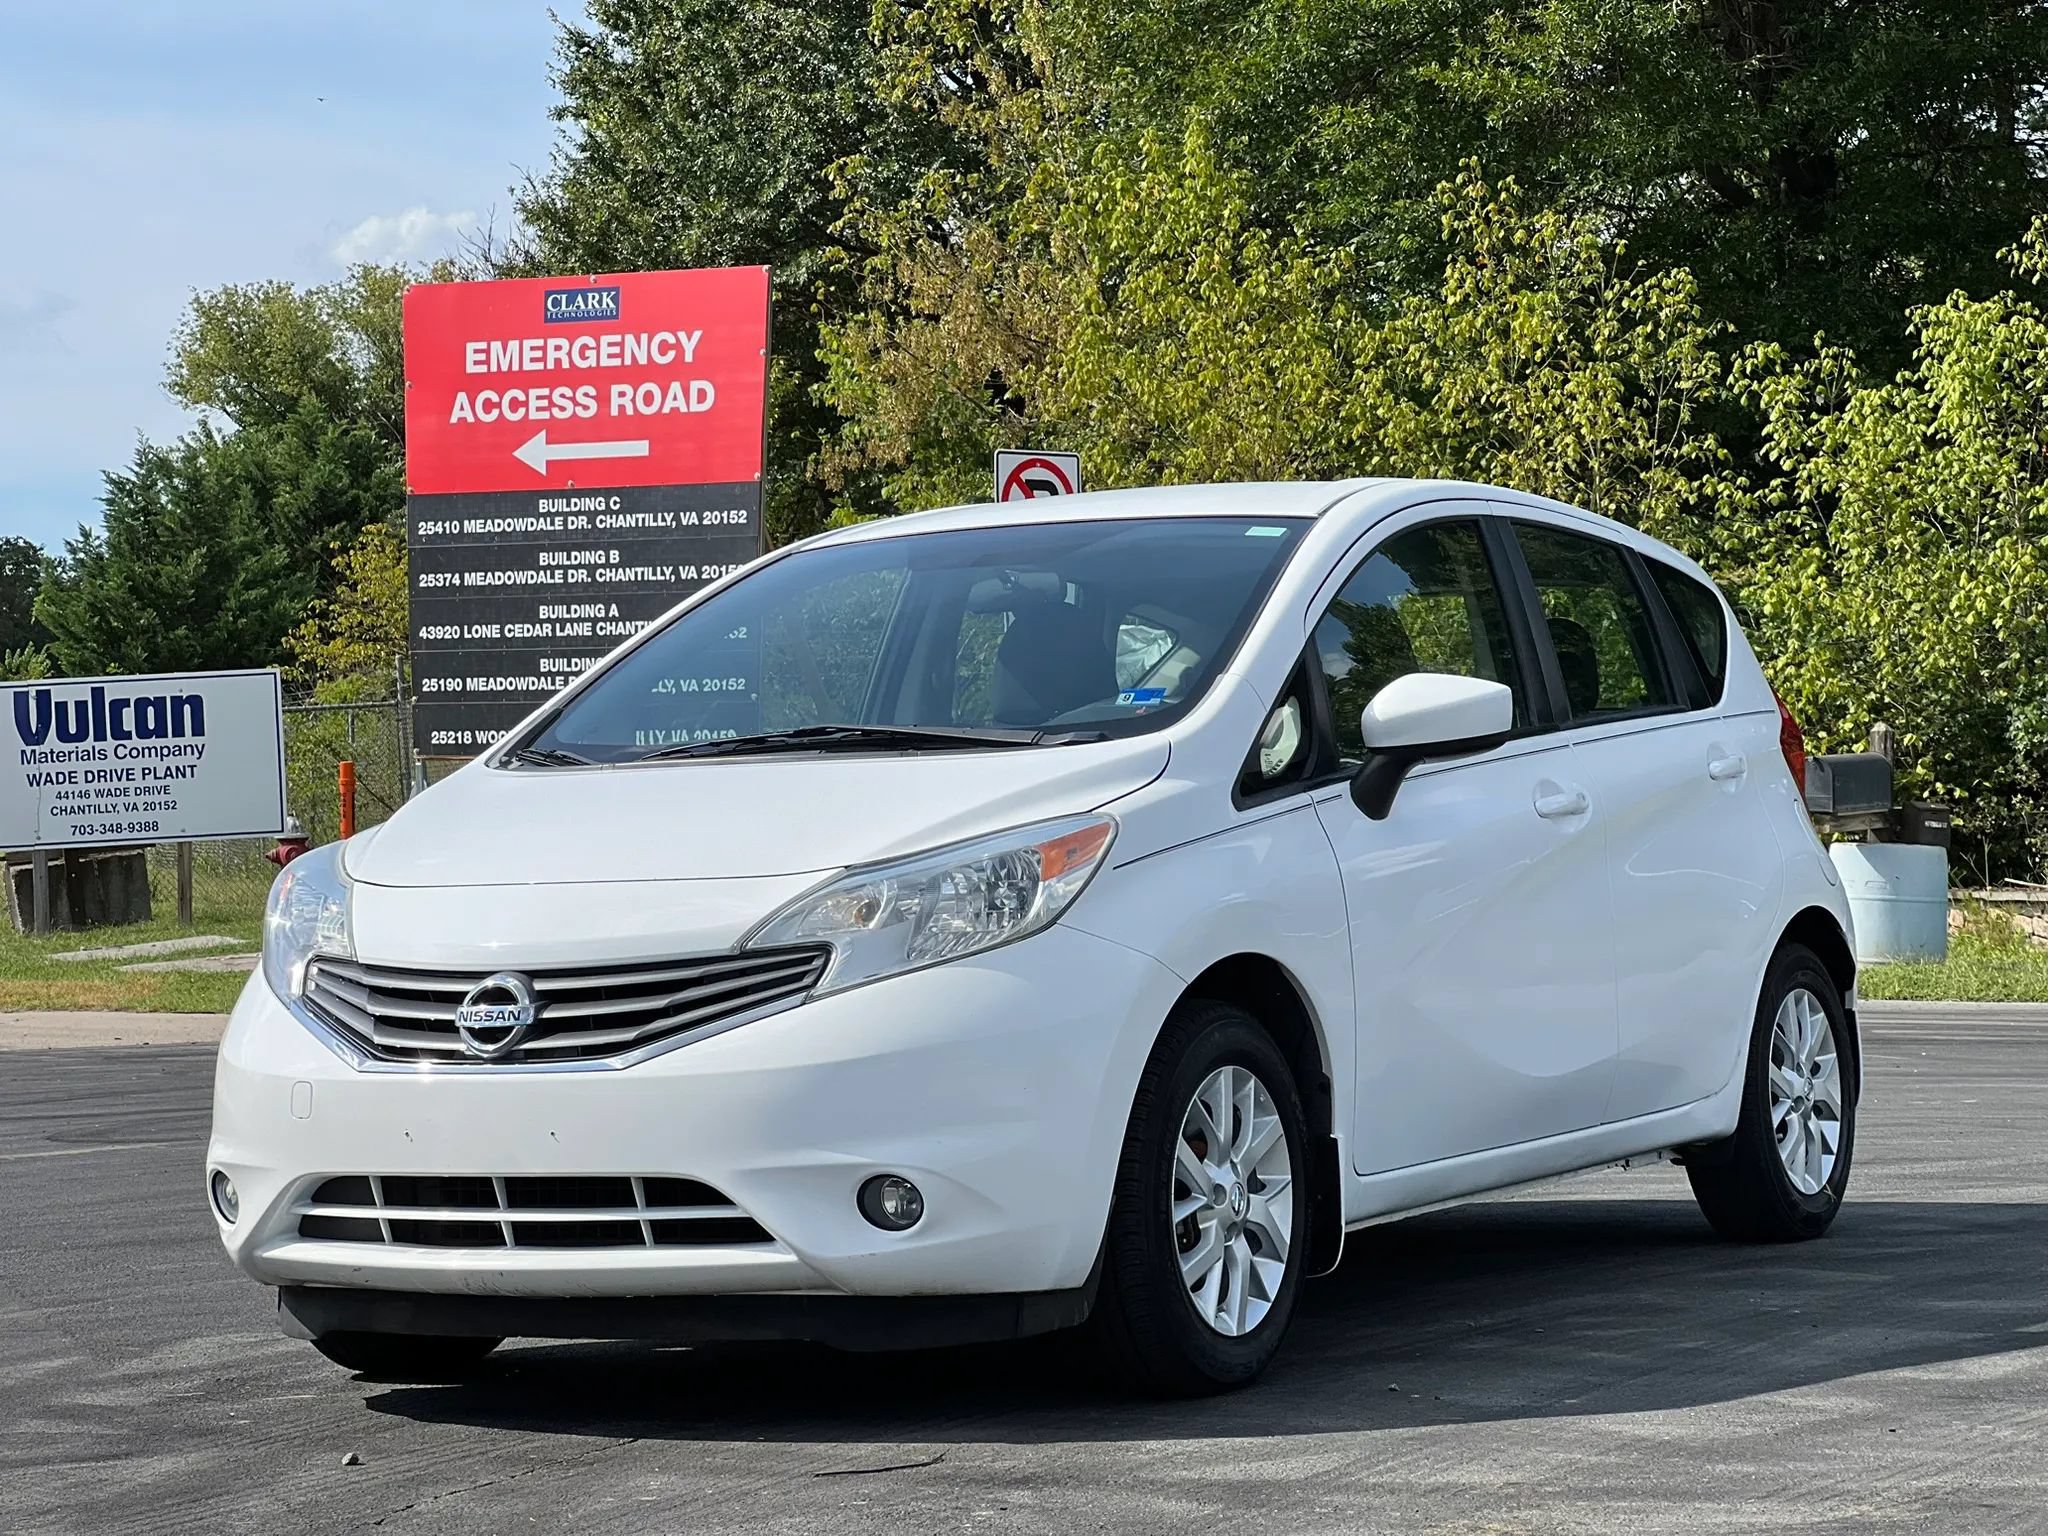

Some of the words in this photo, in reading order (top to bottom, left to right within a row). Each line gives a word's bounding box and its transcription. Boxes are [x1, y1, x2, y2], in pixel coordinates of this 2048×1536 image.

[547, 291, 616, 311] CLARK
[547, 309, 617, 319] TECHNOLOGIES
[465, 330, 703, 374] EMERGENCY
[449, 385, 598, 424] ACCESS
[610, 380, 715, 417] ROAD
[539, 497, 606, 513] BUILDING
[610, 496, 621, 510] C
[418, 520, 460, 535] 25410
[463, 516, 564, 534] MEADOWDALE
[567, 515, 592, 530] DR.
[595, 512, 677, 529] CHANTILLY,
[680, 511, 699, 526] VA
[702, 510, 748, 525] 20152
[539, 550, 606, 566] BUILDING
[609, 550, 620, 564] B
[419, 573, 461, 587] 25374
[464, 569, 564, 586] MEADOWDALE
[567, 568, 592, 583] DR.
[595, 566, 676, 583] CHANTILLY,
[679, 565, 698, 580] VA
[701, 564, 745, 579] 2015
[539, 604, 606, 619] BUILDING
[608, 603, 620, 617] A
[419, 625, 461, 640] 43920
[463, 624, 501, 638] LONE
[504, 622, 552, 638] CEDAR
[556, 622, 593, 636] LANE
[422, 677, 463, 692] 25190
[466, 676, 565, 691] MEADOWDALE
[680, 679, 699, 692] VA
[702, 678, 746, 692] 20152
[13, 686, 206, 746] Vulcan
[431, 730, 473, 745] 25218
[20, 746, 108, 765] Materials
[113, 743, 206, 761] Company
[26, 770, 79, 787] WADE
[84, 768, 136, 784] DRIVE
[141, 764, 198, 781] PLANT
[55, 789, 91, 801] 44146
[94, 787, 131, 799] WADE
[134, 785, 171, 797] DRIVE
[50, 803, 120, 817] CHANTILLY,
[123, 802, 139, 813] VA
[142, 800, 178, 811] 20152
[70, 821, 159, 836] 703-348-9388
[458, 1009, 521, 1023] NISSAN
